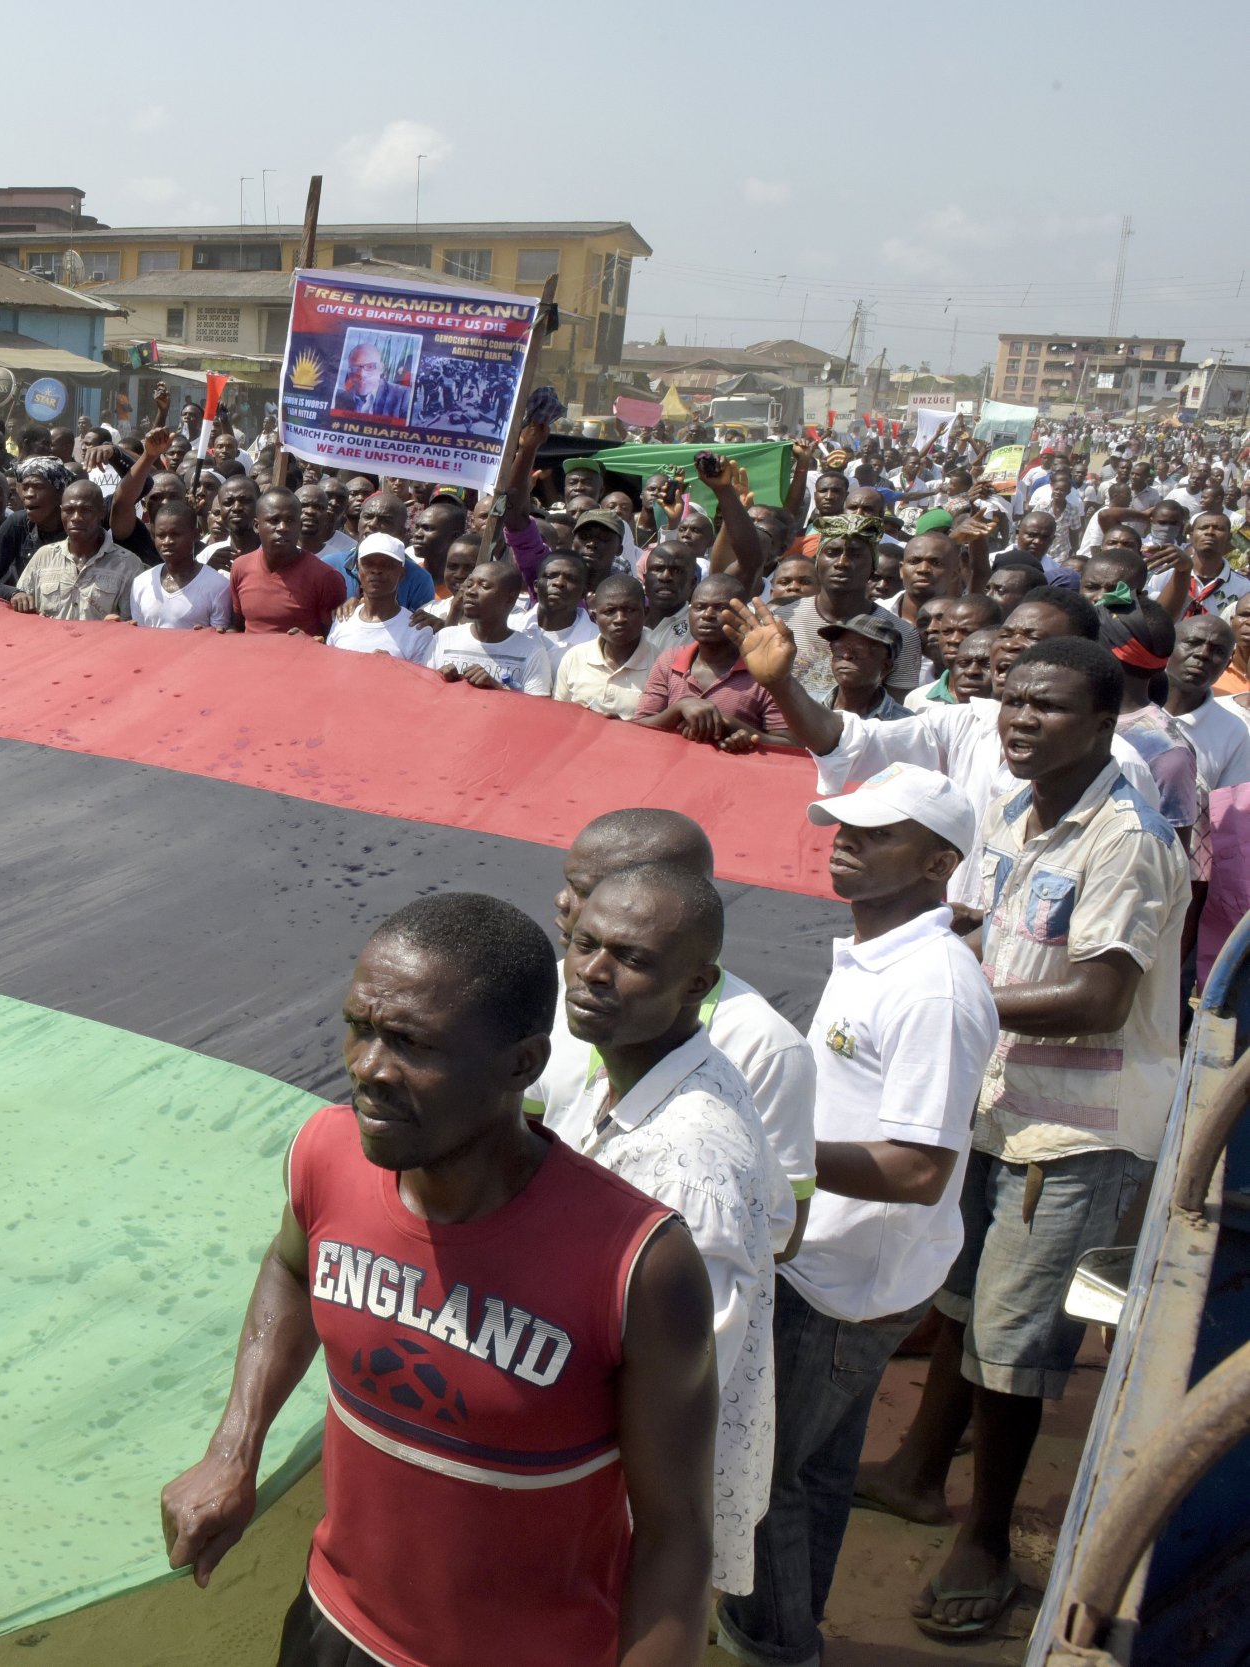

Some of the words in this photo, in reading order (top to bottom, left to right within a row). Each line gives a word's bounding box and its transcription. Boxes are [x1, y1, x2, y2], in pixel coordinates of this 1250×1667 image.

[304, 285, 356, 302] FREE
[360, 294, 452, 314] NNAMDI
[458, 303, 530, 320] KANU
[316, 304, 345, 314] GIVE
[348, 308, 362, 316] US
[366, 310, 412, 322] BIAFRA
[416, 315, 434, 324] OR
[438, 318, 461, 326] LET
[464, 320, 481, 330] US
[484, 322, 508, 332] DIE
[434, 334, 469, 344] GENOCIDE
[470, 338, 487, 348] WAS
[452, 346, 483, 357] AGAINST
[34, 394, 57, 407] STAR
[298, 408, 317, 420] HITLER
[305, 400, 328, 410] WORST
[294, 427, 321, 440] MARCH
[323, 433, 344, 443] FOR
[347, 436, 374, 447] OUR
[374, 440, 420, 452] LEADER
[422, 448, 450, 458] AND
[454, 451, 477, 461] FOR
[344, 424, 359, 432] IN
[363, 427, 420, 440] BIAFRA
[426, 435, 452, 444] WE
[456, 439, 500, 453] STAND
[316, 443, 334, 454] WE
[336, 446, 362, 458] ARE
[364, 450, 450, 470] UNSTOPABLE
[454, 462, 462, 472] !!
[312, 1240, 573, 1388] ENGLAND
